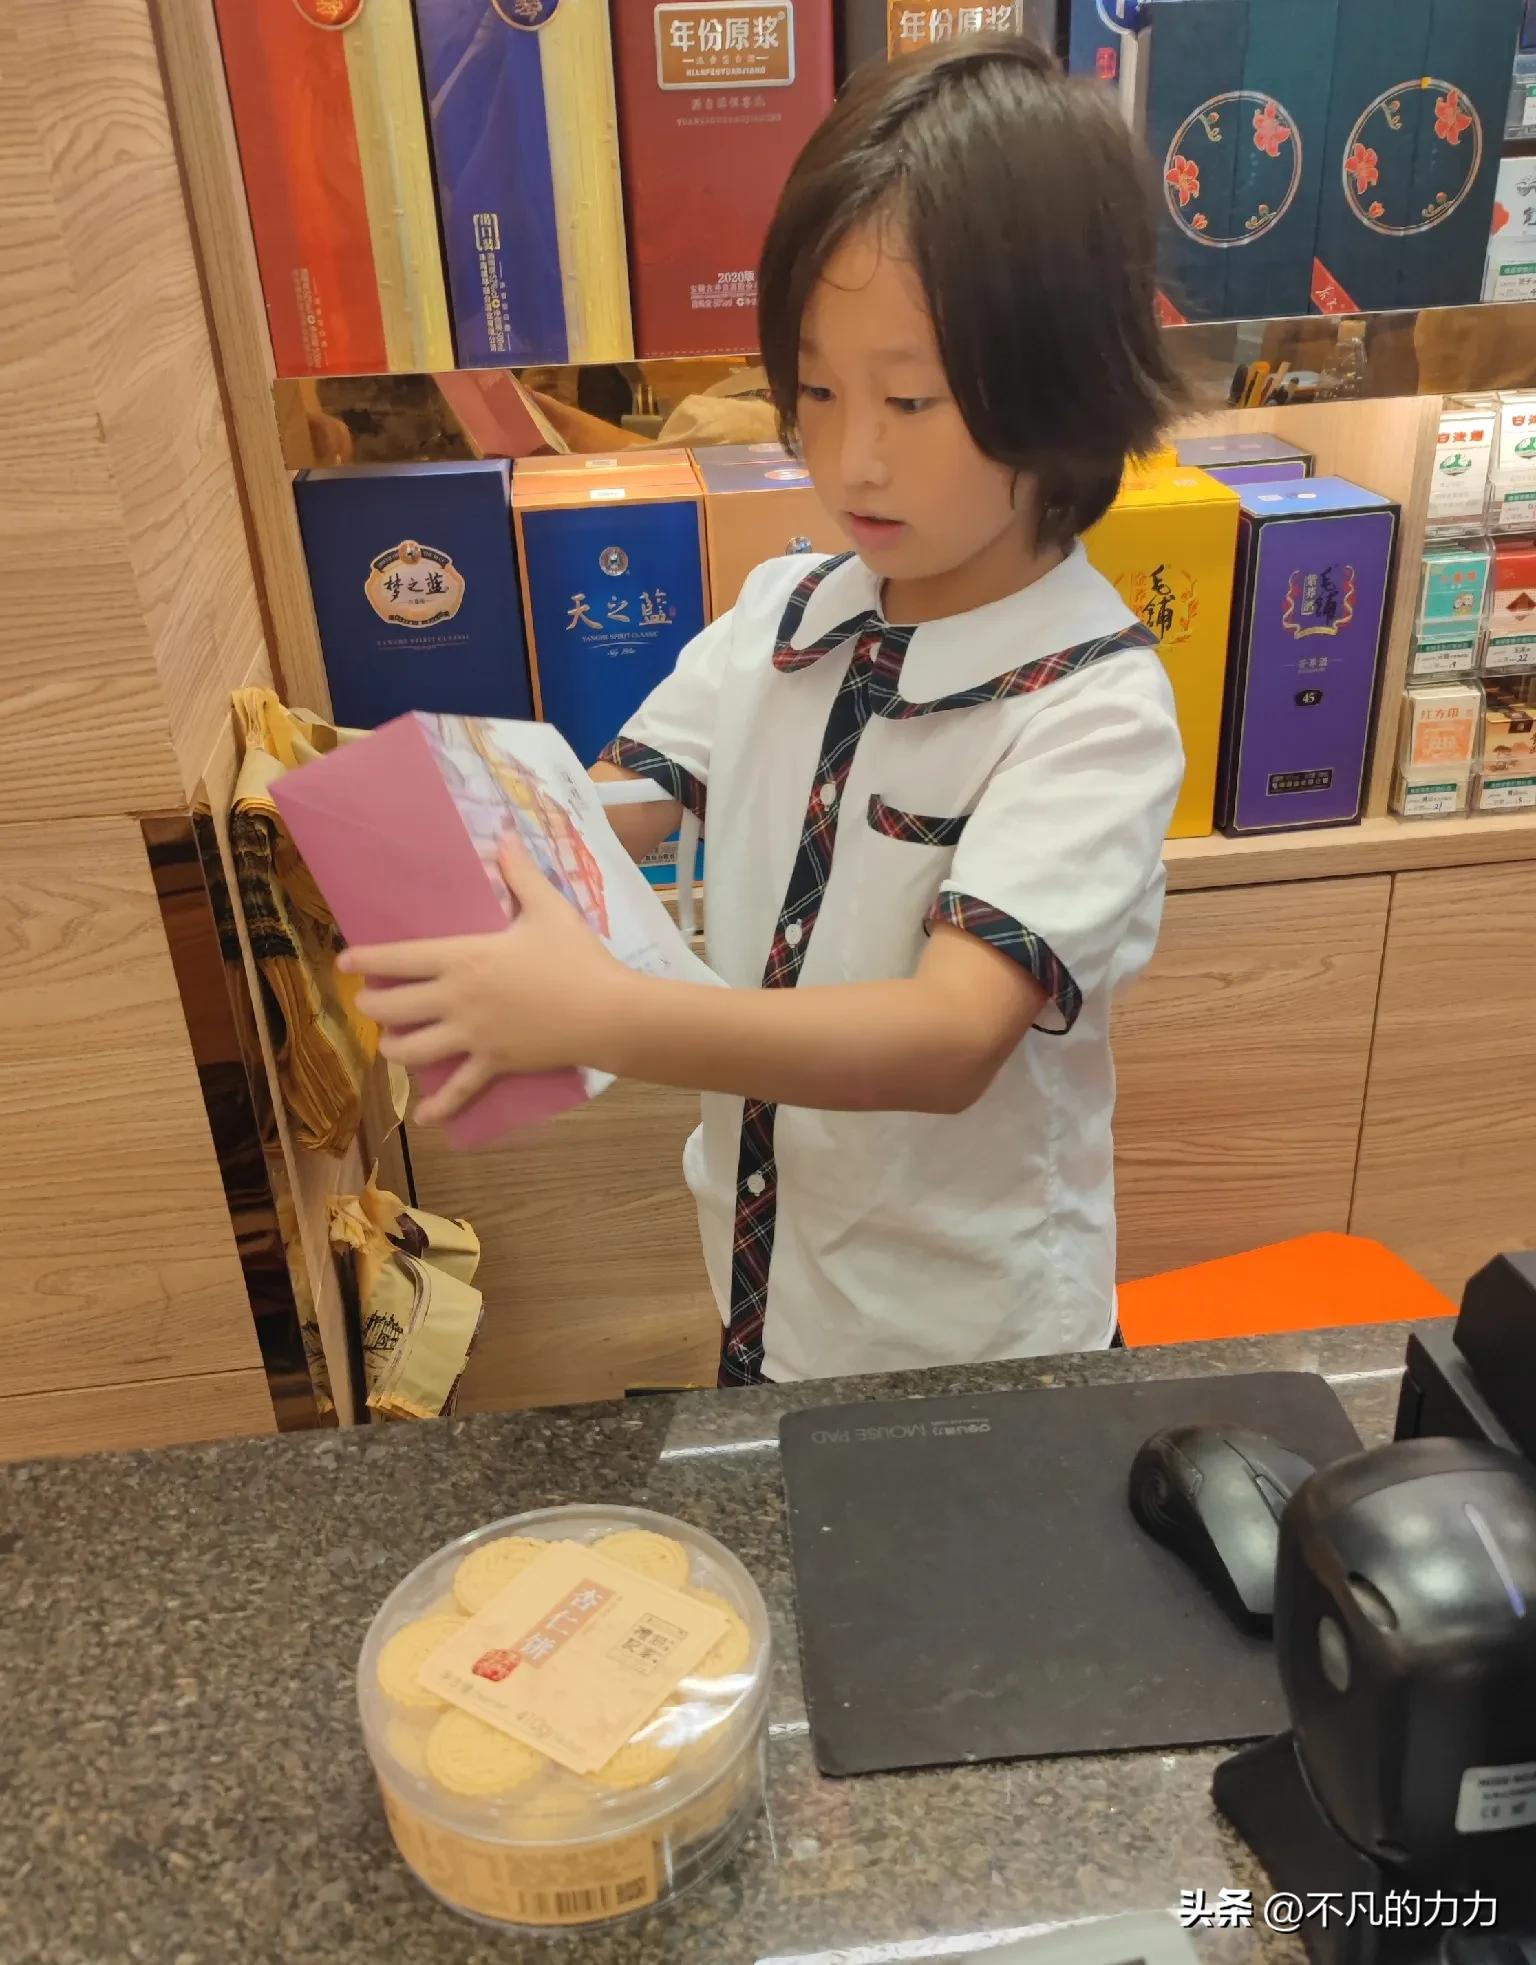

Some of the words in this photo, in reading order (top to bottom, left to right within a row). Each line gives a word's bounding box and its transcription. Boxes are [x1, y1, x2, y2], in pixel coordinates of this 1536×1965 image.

[670, 16, 780, 52] 年份原浆
[1302, 692, 1316, 704] 45
[811, 1430, 849, 1444] PAD
[855, 1424, 927, 1441] MOUSE
